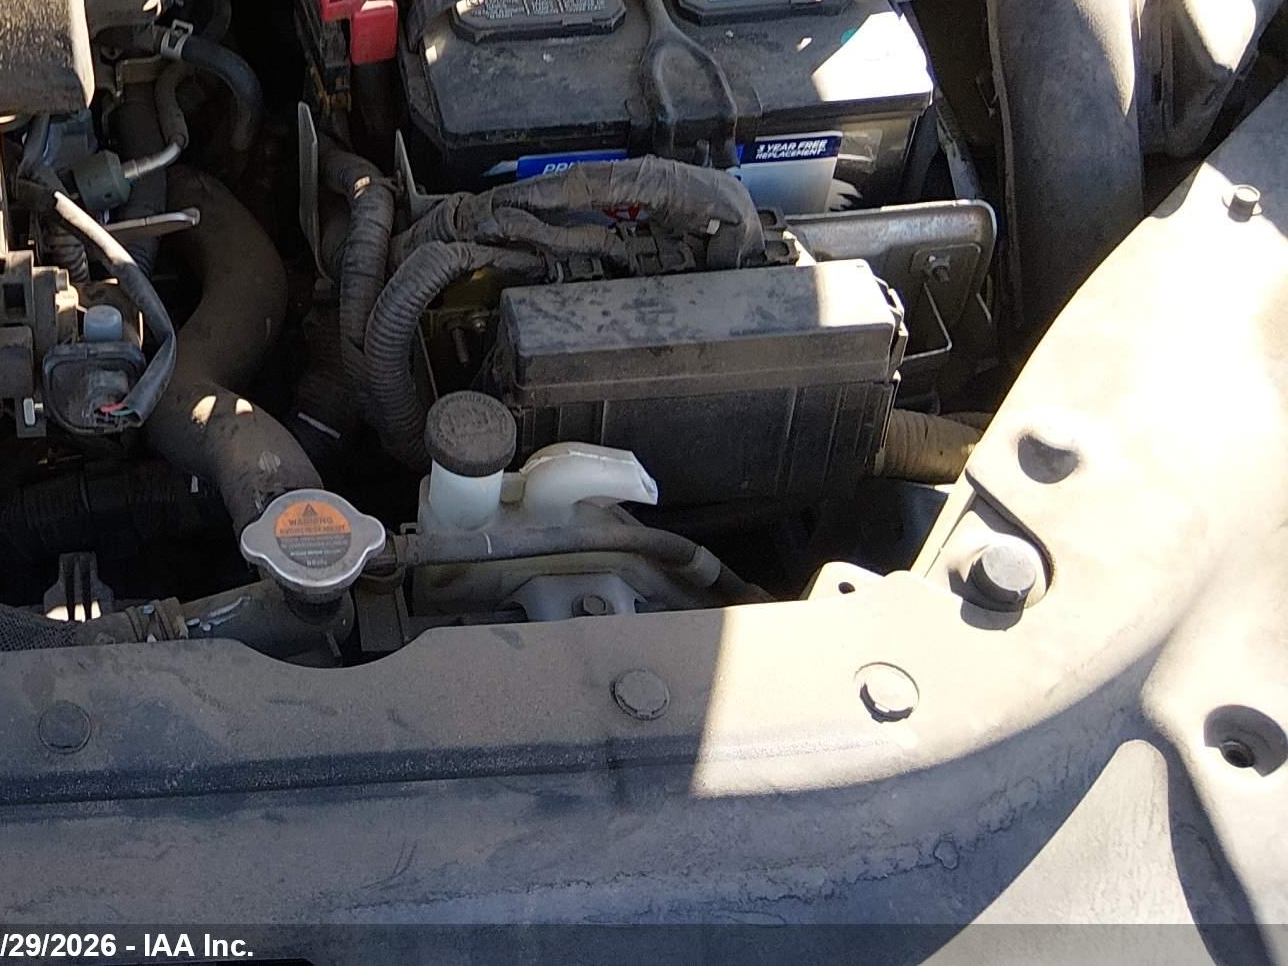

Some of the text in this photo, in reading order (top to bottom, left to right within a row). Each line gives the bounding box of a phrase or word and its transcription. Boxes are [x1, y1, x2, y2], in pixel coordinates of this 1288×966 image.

[768, 142, 796, 153] YEAR
[798, 140, 828, 151] FREE
[756, 149, 825, 160] REPLACEMENT
